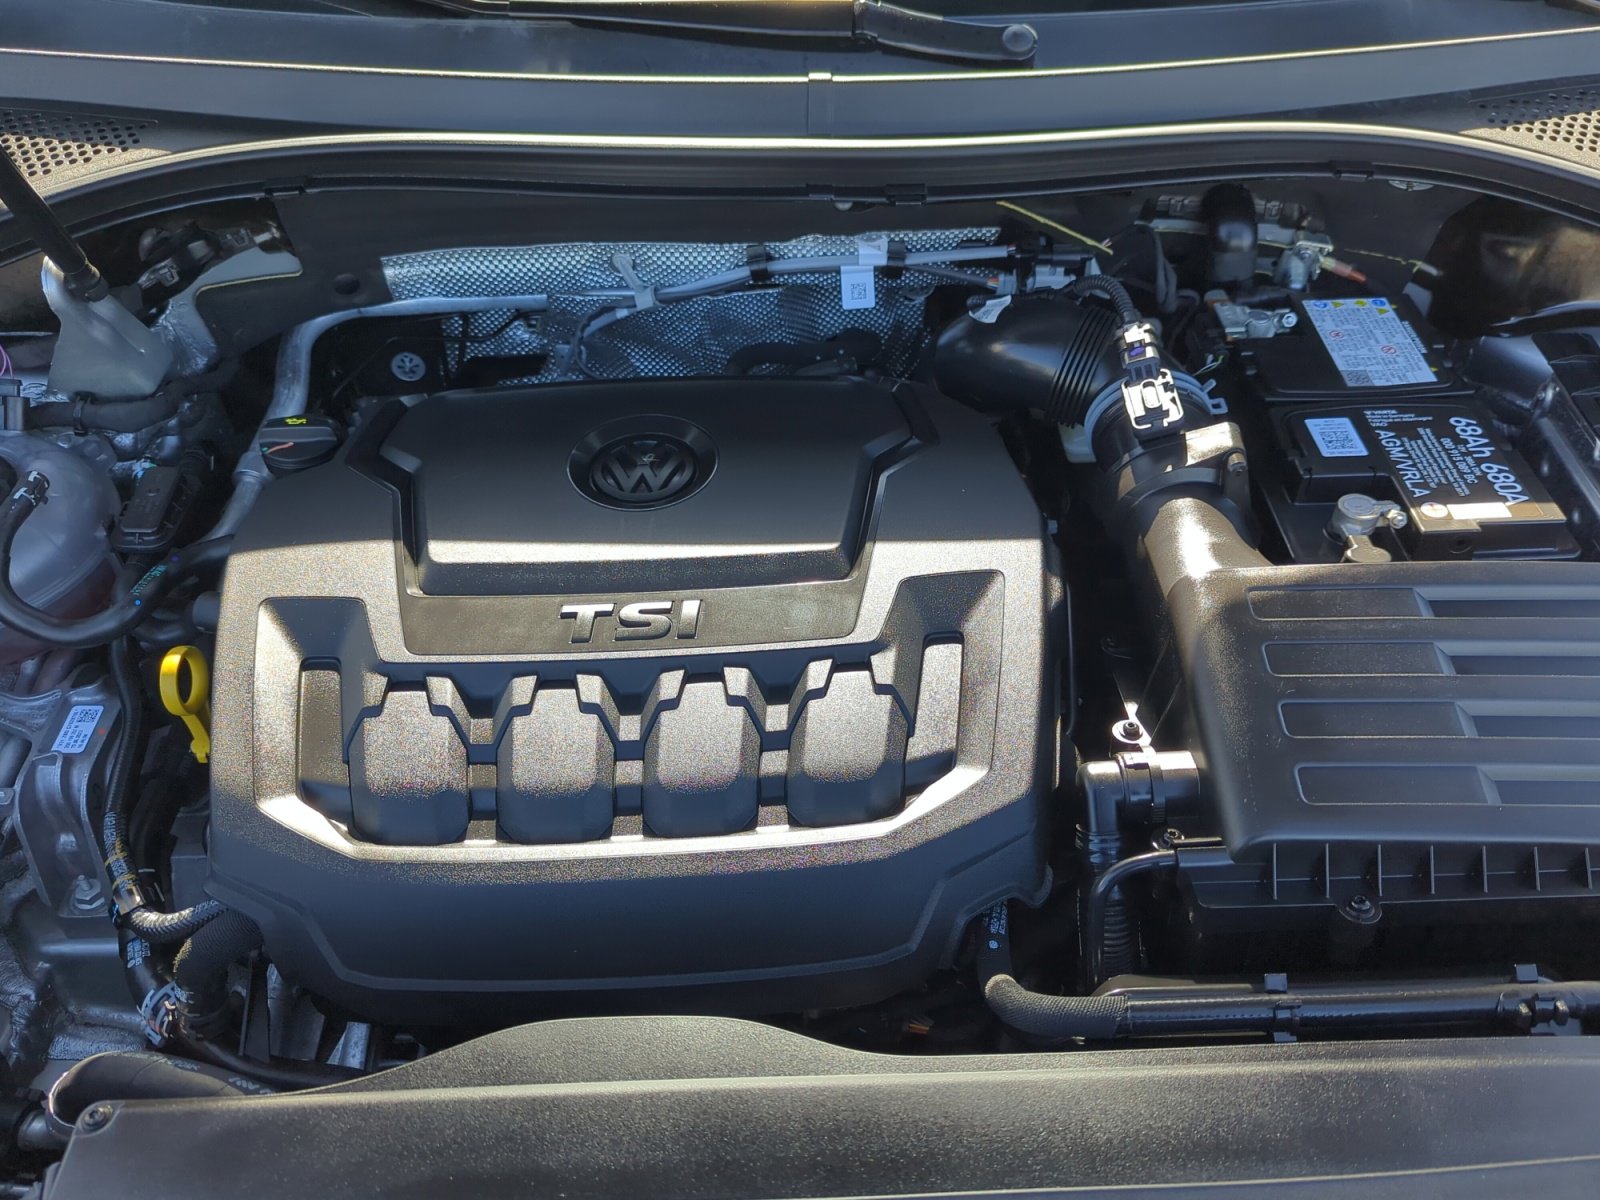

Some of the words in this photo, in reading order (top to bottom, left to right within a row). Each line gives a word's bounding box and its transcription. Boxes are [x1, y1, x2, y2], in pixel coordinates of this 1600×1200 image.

[1375, 430, 1431, 498] AGM/VRLA
[1440, 438, 1455, 453] 000
[1463, 473, 1478, 484] BC
[1450, 417, 1495, 458] 68Ah
[1480, 462, 1529, 505] 680A
[560, 599, 703, 644] TSI
